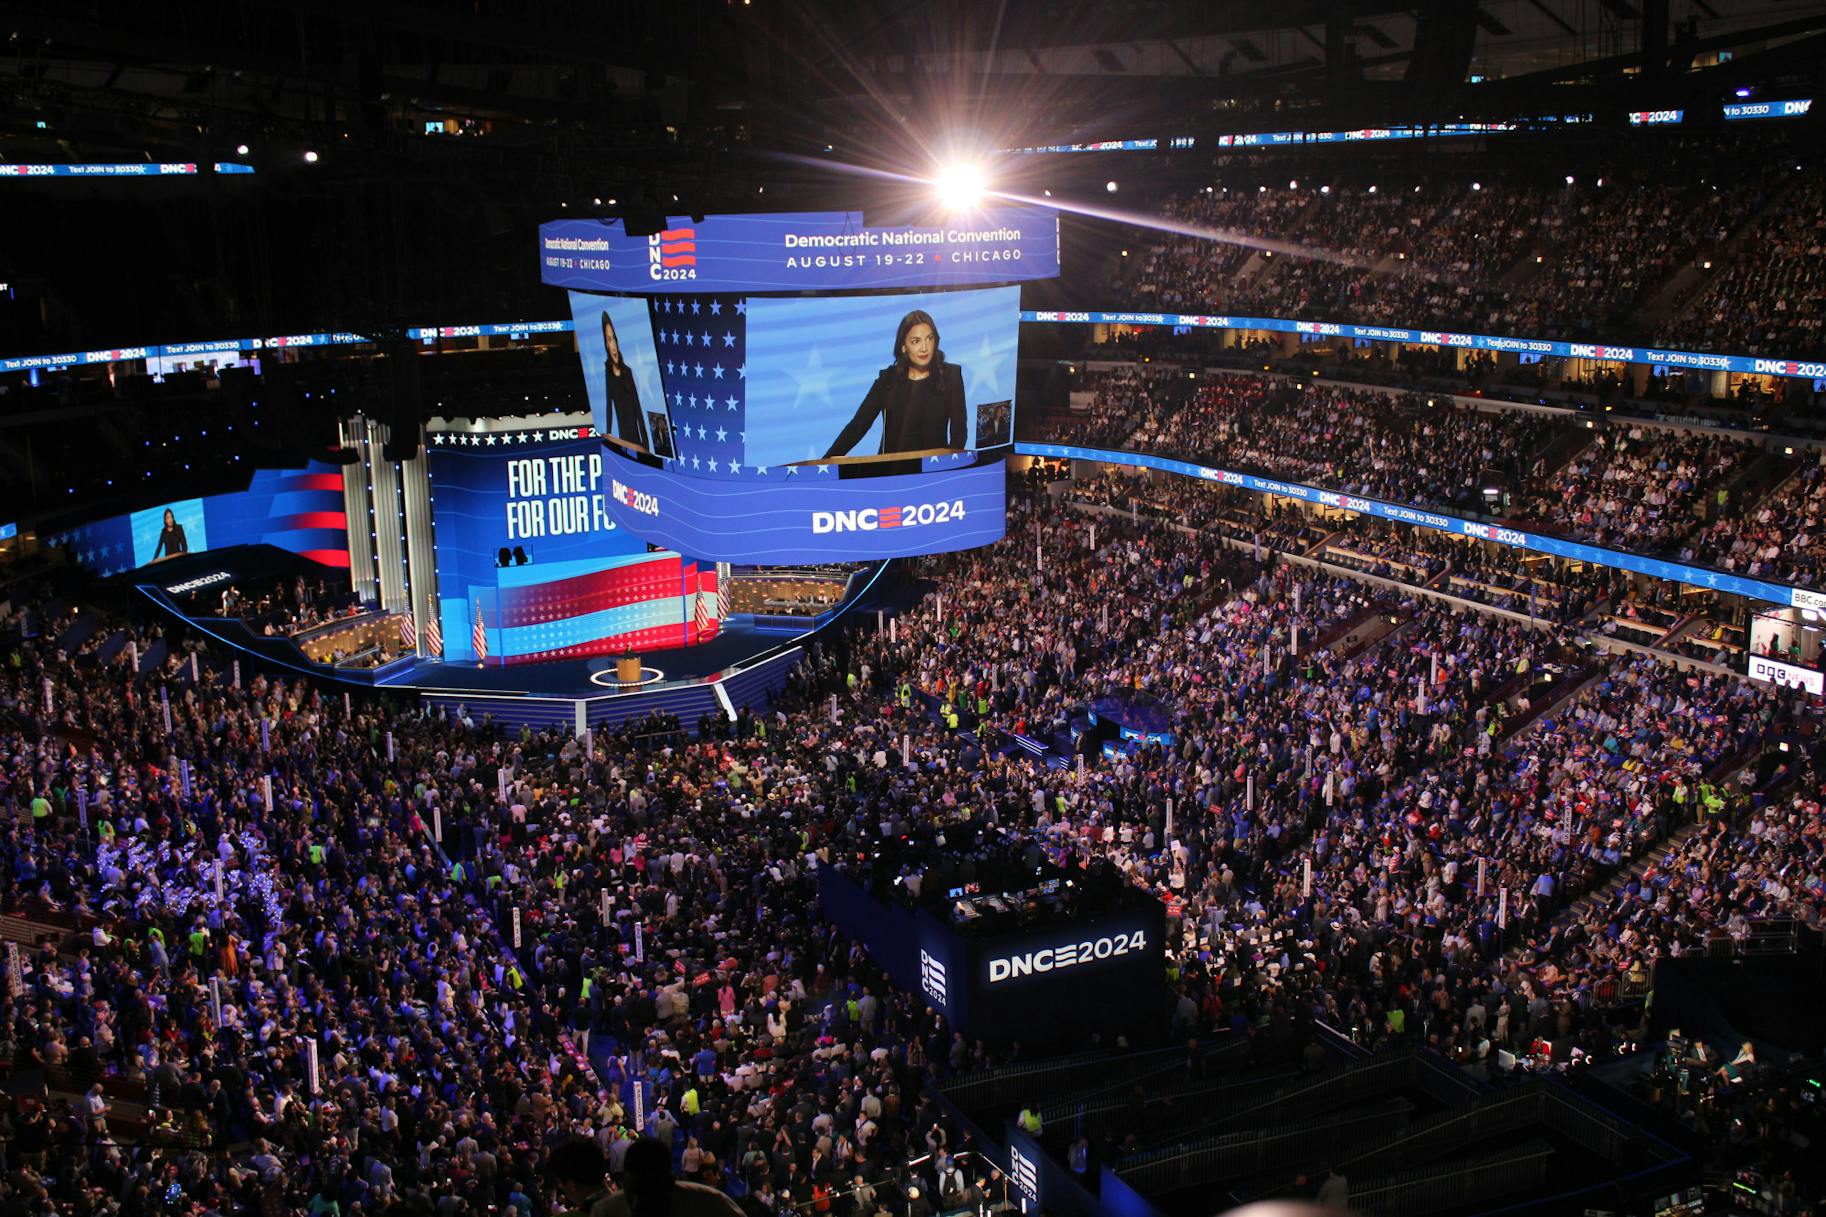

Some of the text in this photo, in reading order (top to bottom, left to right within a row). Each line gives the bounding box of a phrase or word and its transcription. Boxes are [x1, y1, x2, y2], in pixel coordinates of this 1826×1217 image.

[1741, 105, 1769, 115] 30330
[578, 238, 609, 251] Convention
[784, 227, 1021, 248] Democratic National Convention
[580, 259, 610, 270] CHICAGO
[786, 249, 1022, 268] AUGUST 19-22 CHICAGO
[663, 269, 697, 280] 2024
[51, 355, 77, 364] 30330
[1647, 351, 1664, 361] Text
[1665, 354, 1687, 363] JOIN
[507, 458, 546, 498] FOR
[549, 455, 586, 494] THE
[507, 500, 546, 539] FOR
[549, 496, 589, 535] OUR
[1398, 508, 1416, 520] JOIN
[1425, 515, 1448, 527] 30330
[1788, 672, 1814, 686] NEWS
[12, 949, 21, 987] OREGON
